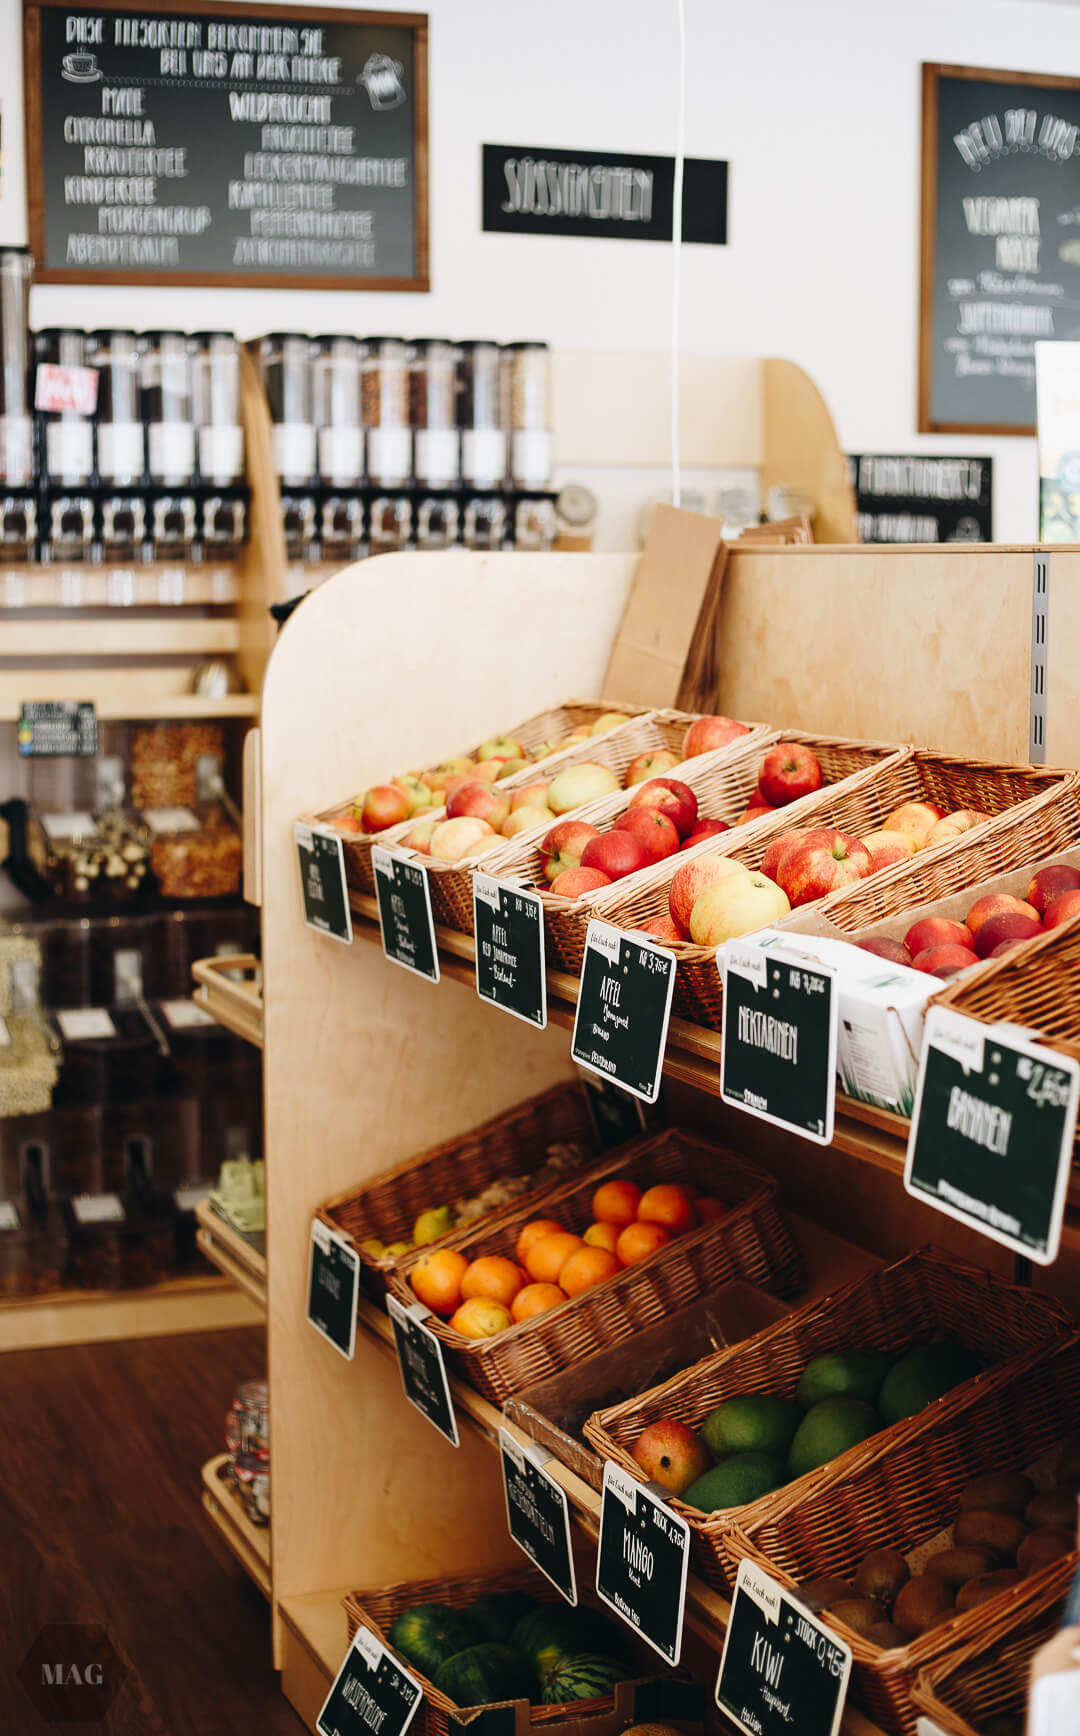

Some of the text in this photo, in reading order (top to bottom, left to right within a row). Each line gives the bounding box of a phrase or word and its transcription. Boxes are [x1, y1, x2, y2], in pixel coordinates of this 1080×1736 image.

[600, 975, 620, 1007] APFEL
[738, 1005, 798, 1065] NEKTARINEN
[623, 1527, 654, 1581] MANGO
[750, 1631, 785, 1689] KIWI
[795, 1617, 818, 1650] STÜCK
